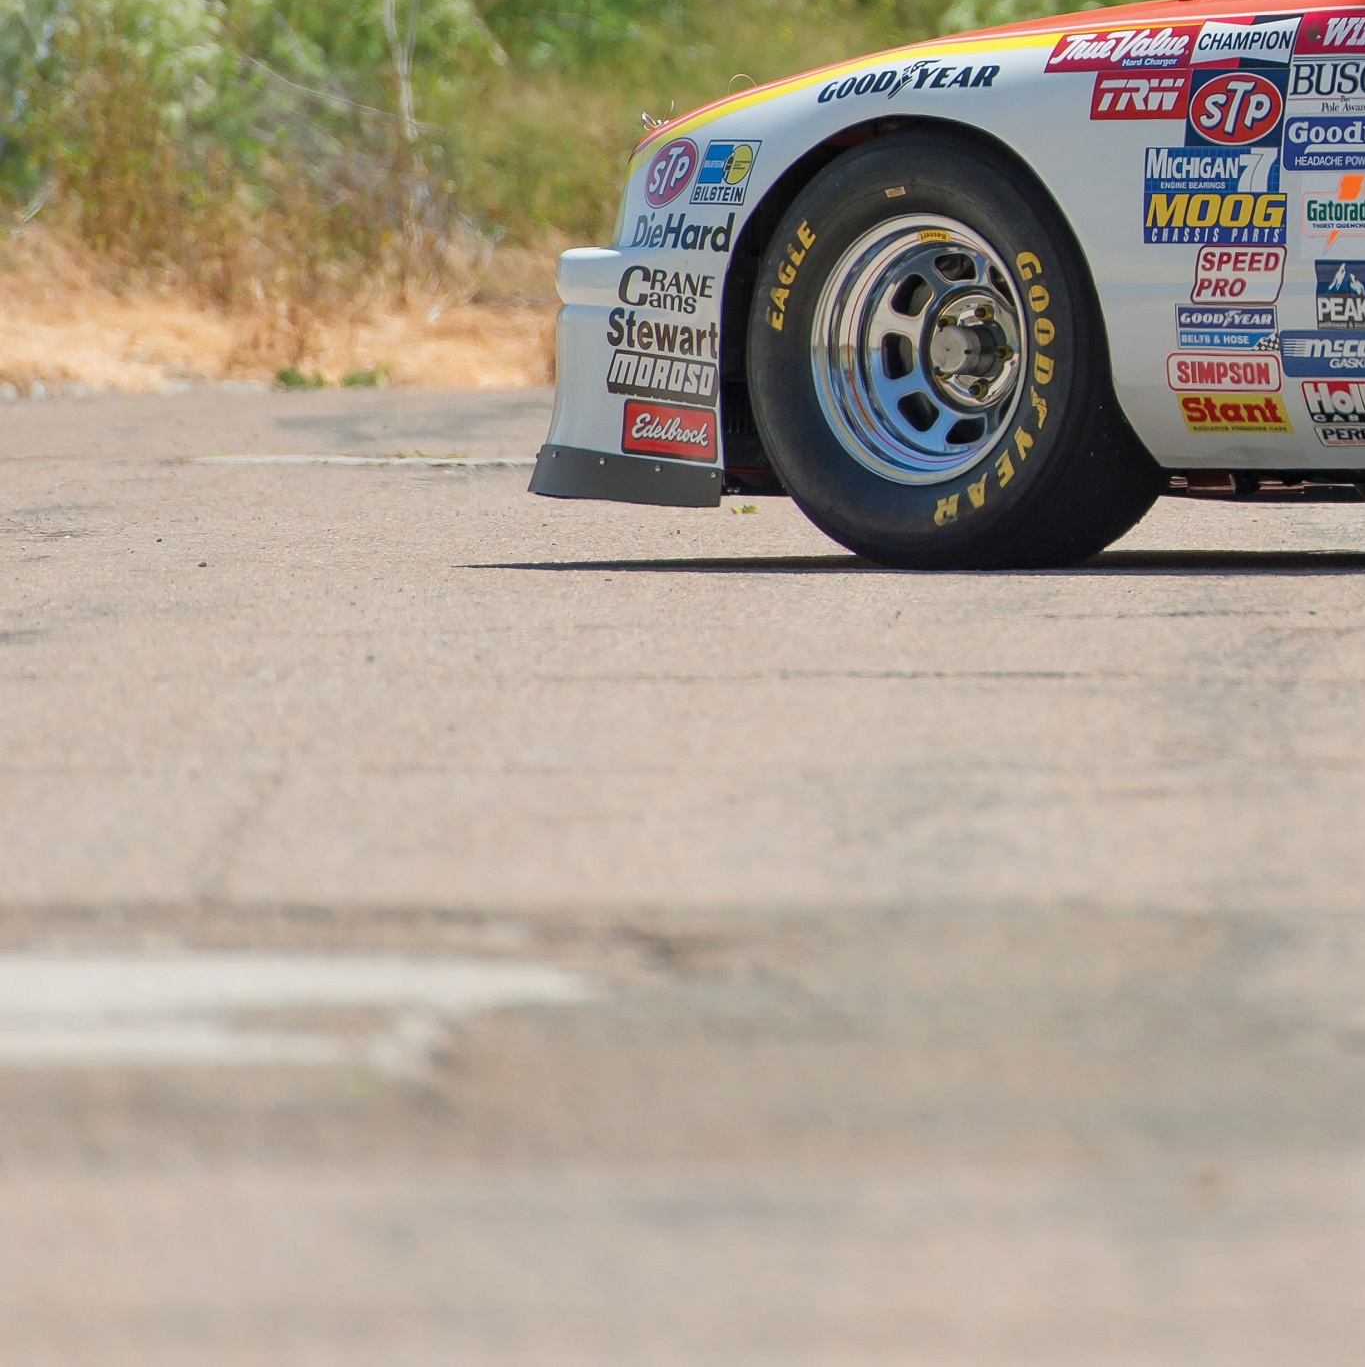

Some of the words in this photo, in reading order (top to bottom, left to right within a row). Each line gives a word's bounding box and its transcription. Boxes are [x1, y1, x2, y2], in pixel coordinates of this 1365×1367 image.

[1198, 29, 1293, 51] CHAMPION
[1122, 58, 1143, 67] Hard
[1144, 57, 1178, 67] Charger
[1097, 78, 1186, 111] TRW
[1200, 80, 1271, 133] STP
[1321, 102, 1340, 112] Pole
[648, 146, 691, 195] STP
[1146, 148, 1240, 179] MICHIGAN
[1294, 155, 1343, 166] HEADACHE
[693, 185, 744, 202] BILSTEIN
[1160, 181, 1187, 190] ENGINE
[1188, 181, 1226, 190] BEARINGS
[1146, 193, 1286, 228] MOOG
[630, 212, 736, 253] DieHard
[1152, 228, 1220, 243] CHASSIS
[1231, 228, 1281, 243] PARTS
[1201, 251, 1280, 273] SPEED
[765, 220, 817, 332] EAGLE
[1196, 277, 1247, 298] PRO
[607, 307, 718, 360] Stewart
[1181, 334, 1211, 344] BELTS
[1213, 335, 1220, 344] &
[1223, 335, 1250, 344] HOSE
[608, 352, 717, 397] MOROSO
[1177, 361, 1271, 384] SIMPSON
[1181, 397, 1283, 423] Stant
[631, 413, 709, 447] Edelbrock
